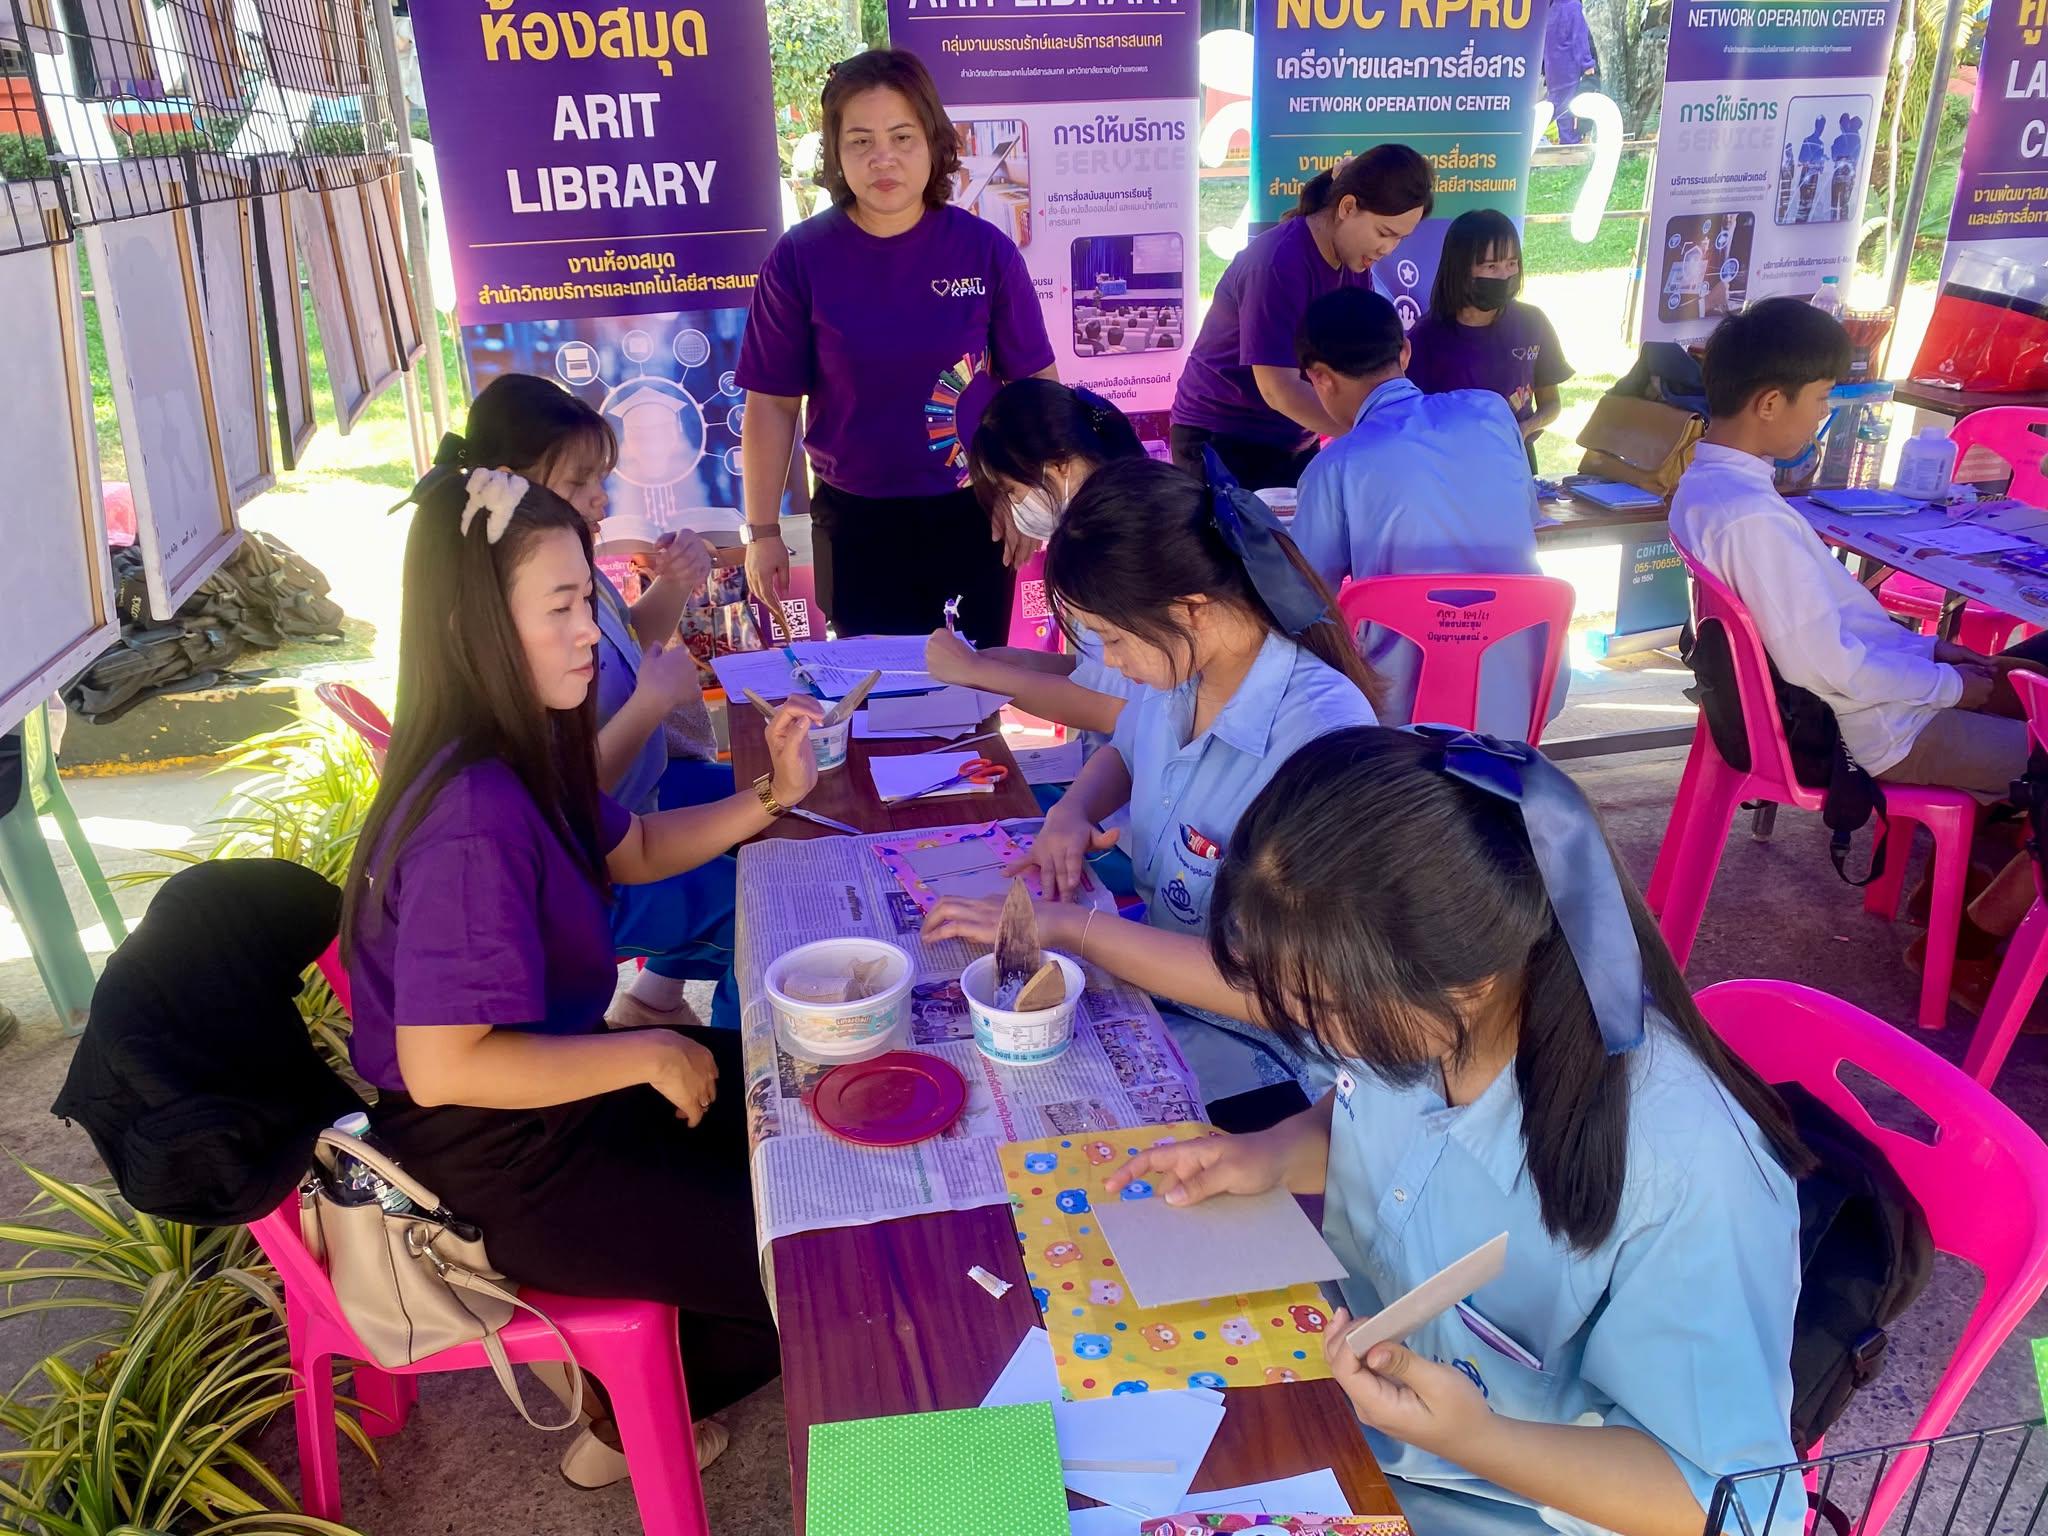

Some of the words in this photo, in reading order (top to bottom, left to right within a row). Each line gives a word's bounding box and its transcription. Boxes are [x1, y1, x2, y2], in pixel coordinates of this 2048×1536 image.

[1688, 8, 1754, 28] NETWORK
[1757, 8, 1830, 28] OPERATION
[1832, 8, 1886, 27] CENTER
[481, 0, 709, 77] ห้องสมุด
[941, 33, 1163, 56] กลุ่มงานบรรณรักษ์และบริการสารสนเทศ
[1276, 39, 1526, 80] เครือข่ายและการสื่อสาร
[2005, 59, 2048, 98] LA
[552, 92, 661, 142] ARIT
[1289, 96, 1362, 113] NETWORK
[1366, 95, 1452, 112] OPERATION
[1455, 95, 1511, 112] CENTER
[1679, 94, 1779, 123] การให้บริการ
[1053, 114, 1186, 146] การให้บริการ
[1678, 126, 1777, 153] SERVICE
[1055, 146, 1186, 176] SERVICE
[506, 160, 717, 214] LIBRARY
[568, 250, 676, 275] งานห้องสมุด
[478, 272, 759, 306] สำนักวิทยบริการและเทคโนโลยีสารสนเท
[951, 277, 983, 288] ARIT
[951, 286, 986, 297] KPRU
[1634, 556, 1682, 574] 055-706555
